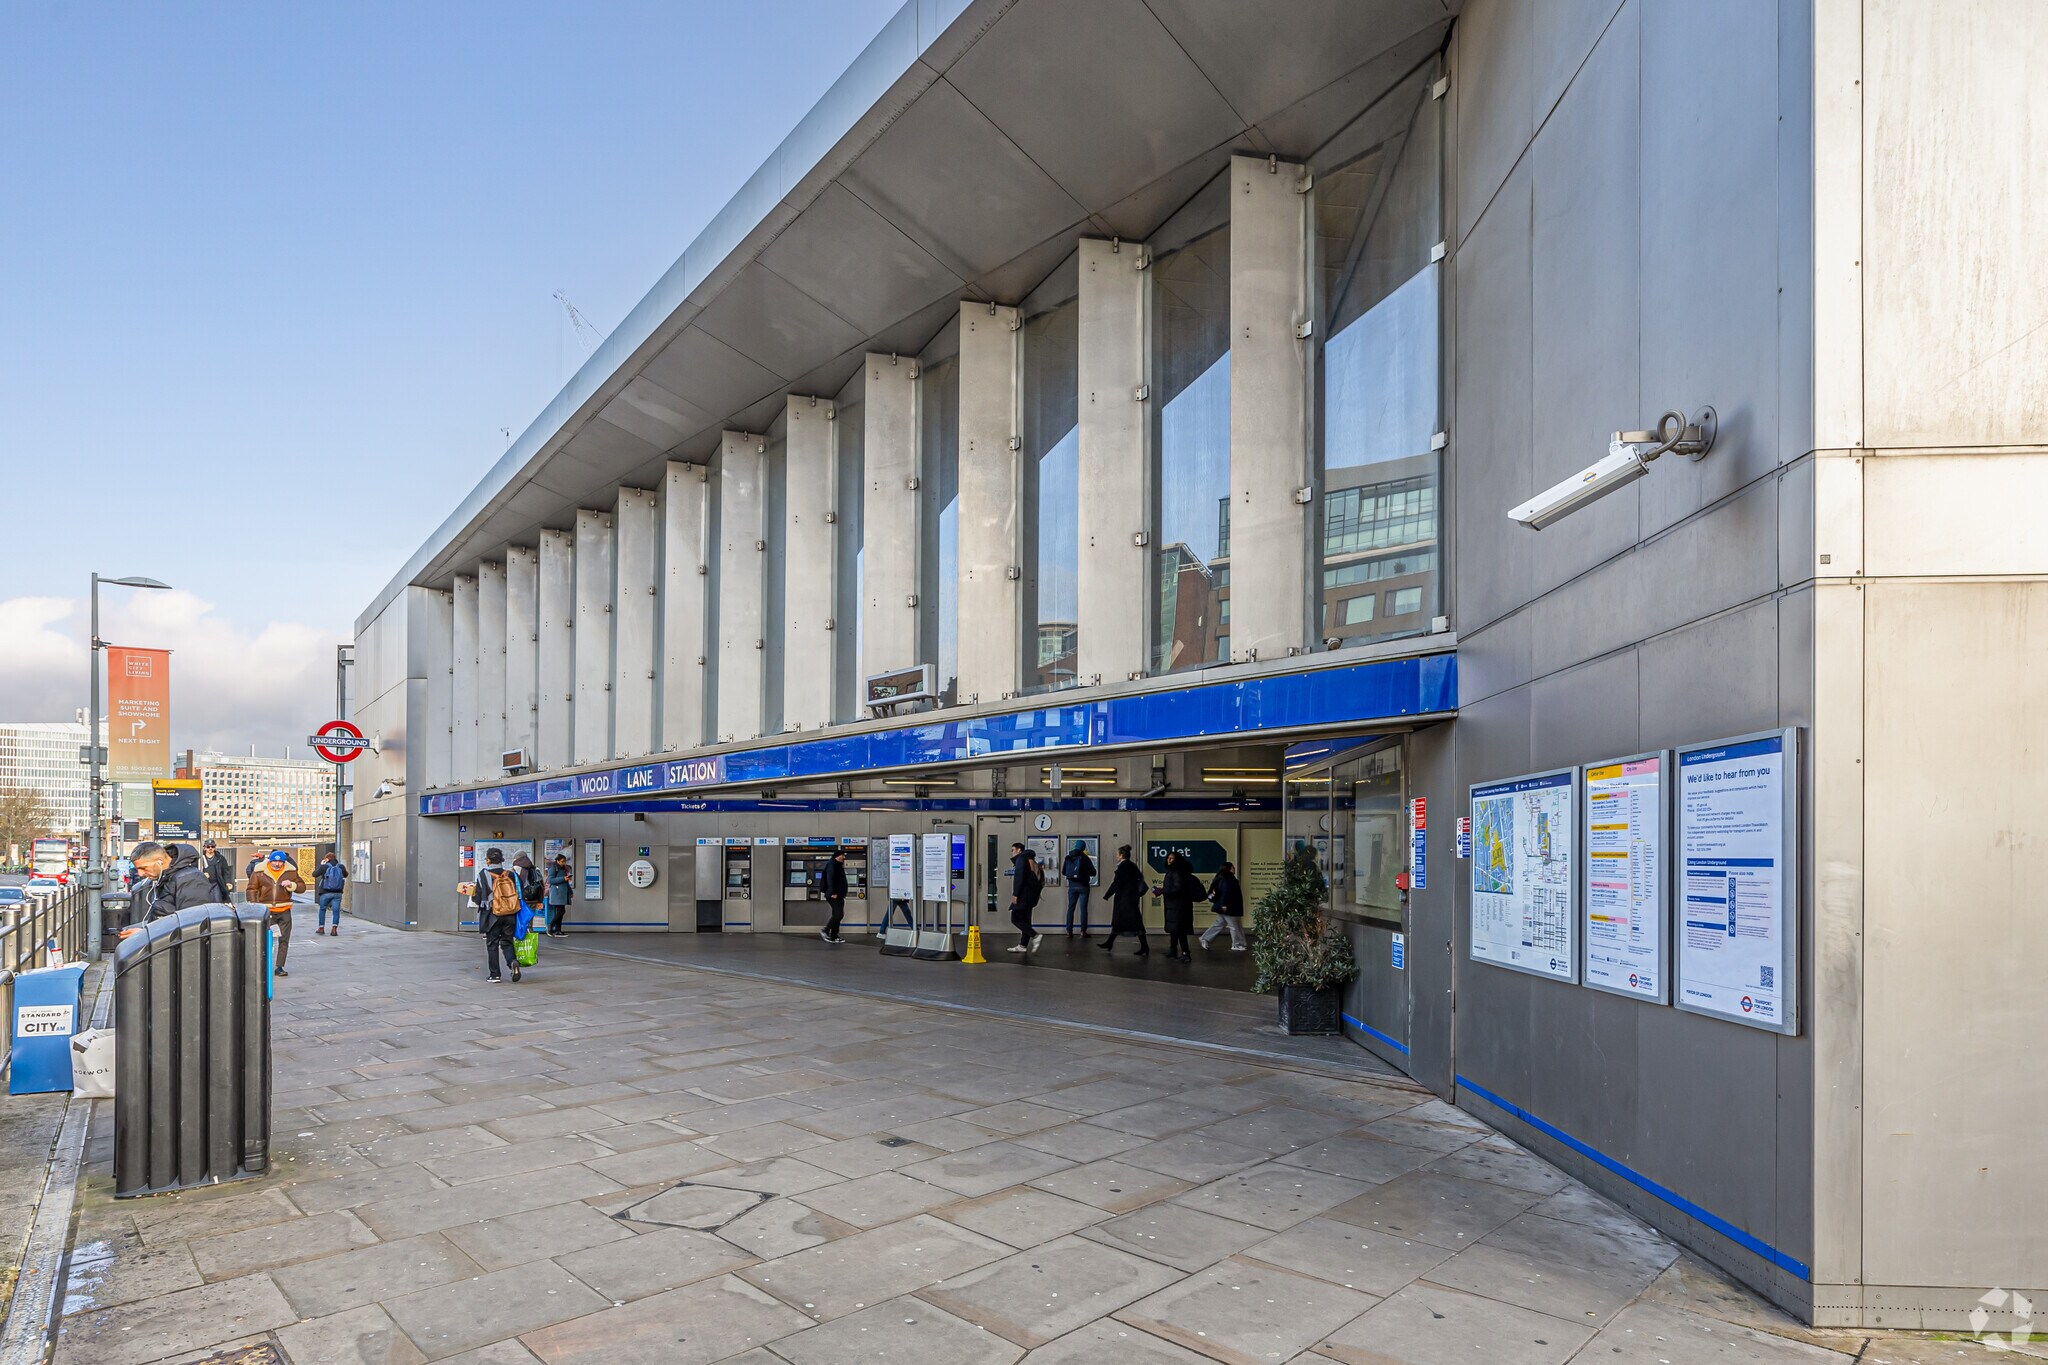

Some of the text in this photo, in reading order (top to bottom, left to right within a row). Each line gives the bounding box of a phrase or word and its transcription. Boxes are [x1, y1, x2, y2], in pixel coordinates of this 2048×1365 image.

[312, 738, 368, 746] UNDERGROUND
[1702, 750, 1726, 760] Underground
[581, 762, 716, 793] WOOD LANE STATION
[1688, 774, 1702, 783] We'd
[1703, 773, 1713, 782] like
[1724, 771, 1737, 779] hear
[1739, 769, 1755, 777] from
[1757, 768, 1770, 777] you
[1152, 846, 1167, 857] To
[25, 1022, 57, 1032] CITY
